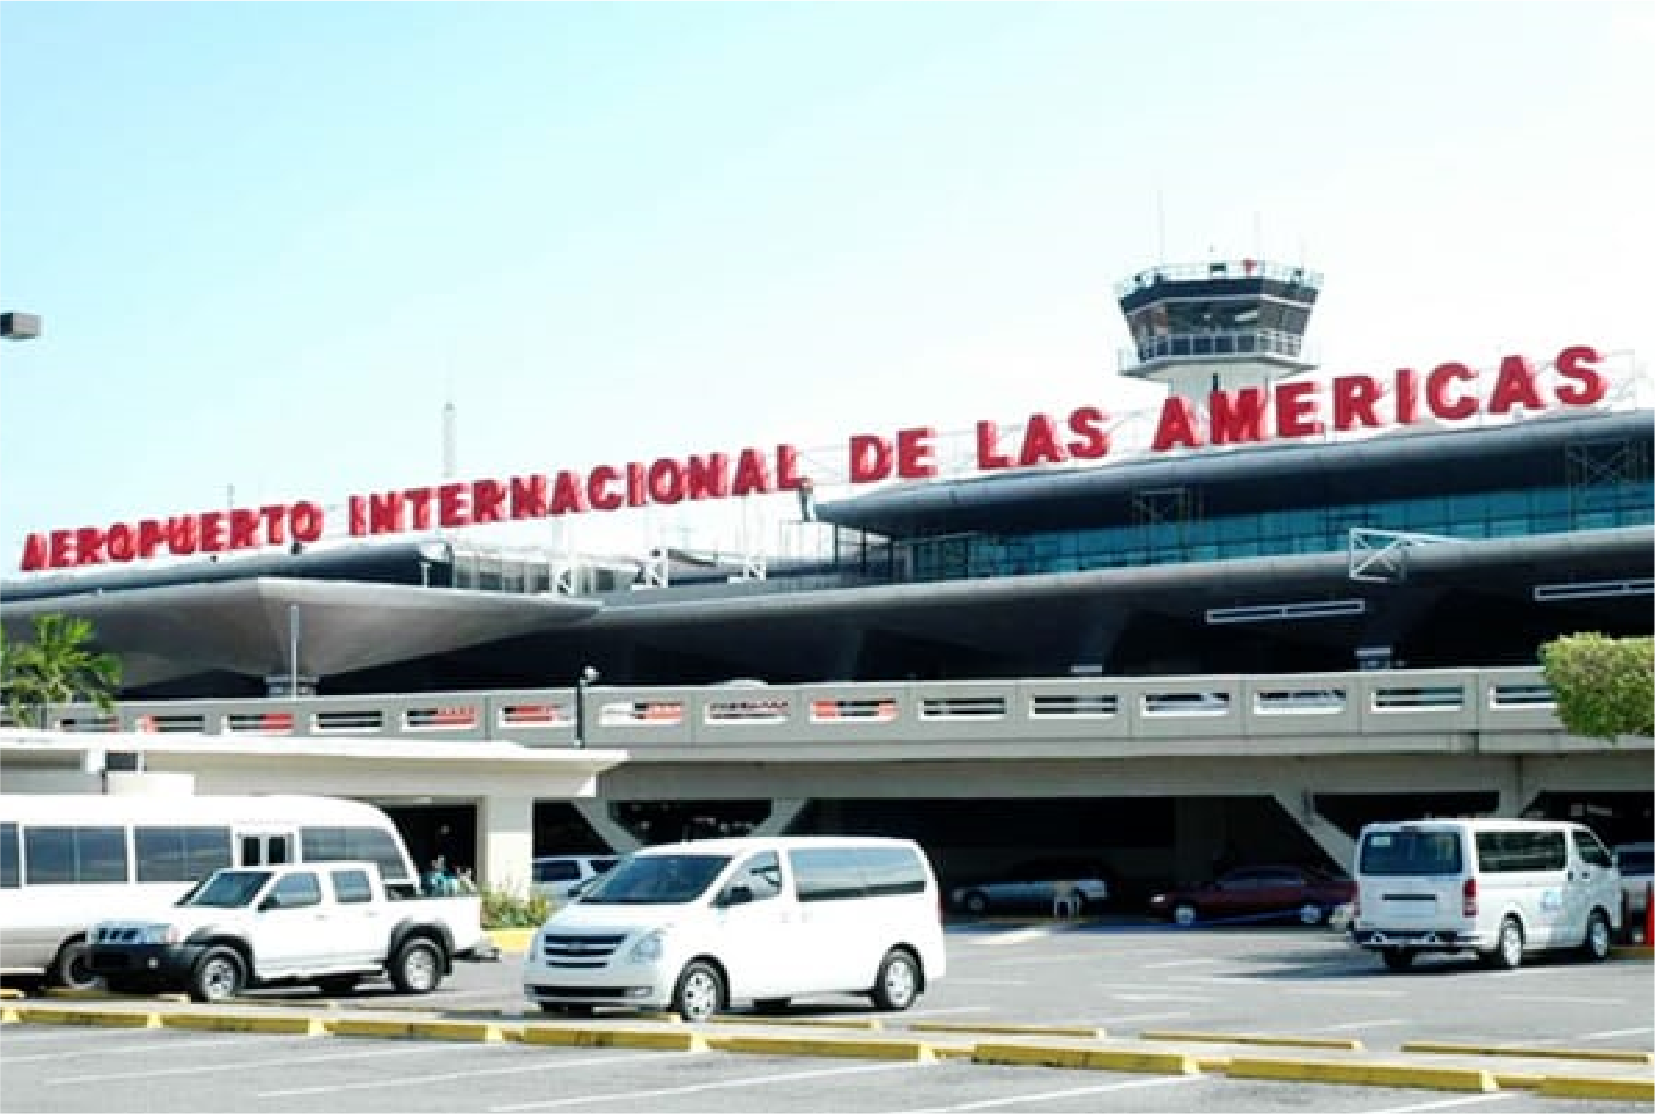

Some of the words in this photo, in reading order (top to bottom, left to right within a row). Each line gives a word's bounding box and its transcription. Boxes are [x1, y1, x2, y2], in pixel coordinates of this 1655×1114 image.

[21, 501, 324, 571] AEROPUERTO
[348, 444, 806, 537] INTERNACIONAL
[849, 427, 937, 482] DE
[976, 406, 1111, 471] LAS
[1152, 345, 1608, 452] AMERICAS
